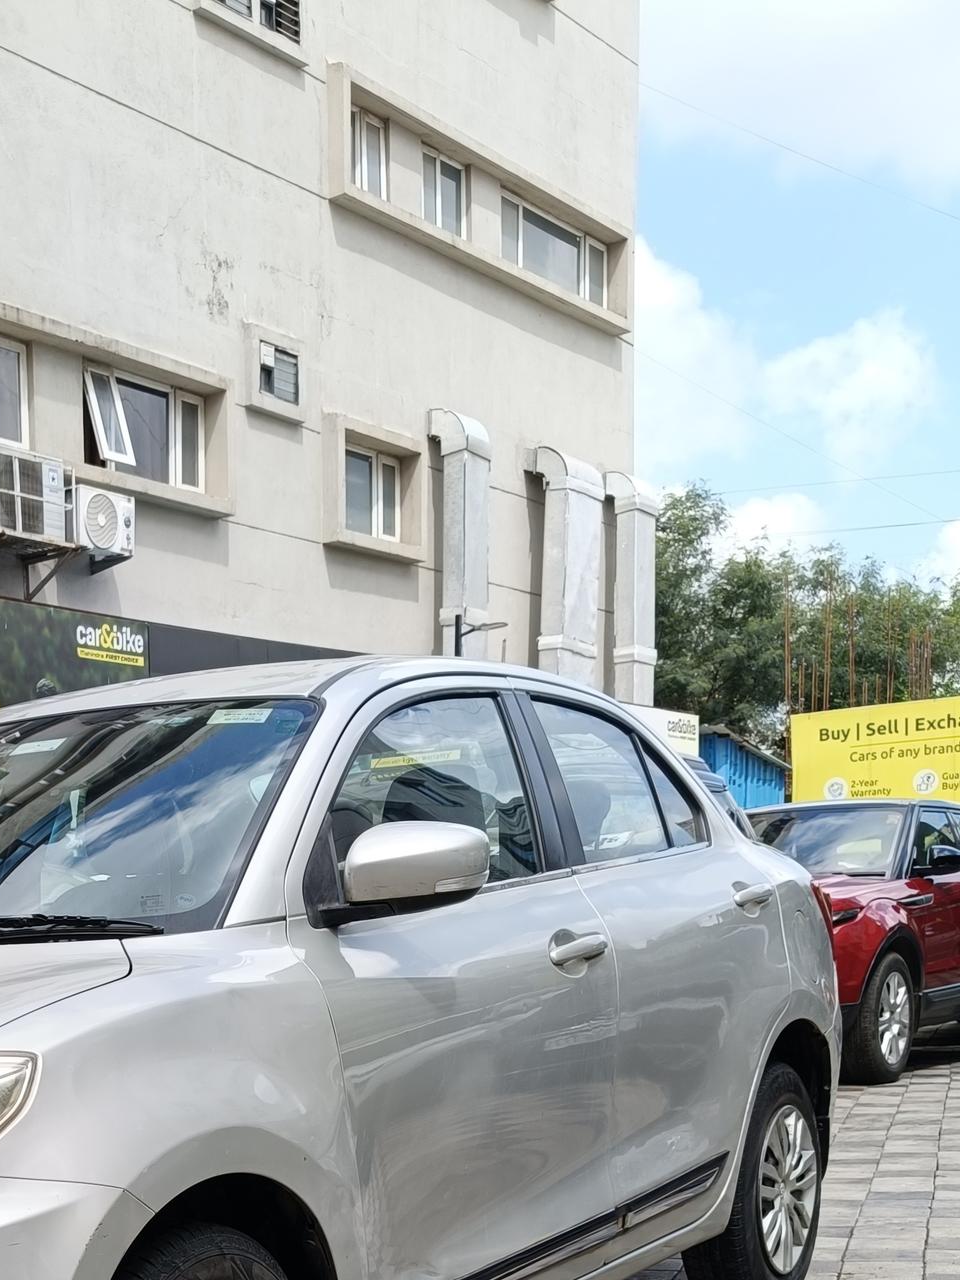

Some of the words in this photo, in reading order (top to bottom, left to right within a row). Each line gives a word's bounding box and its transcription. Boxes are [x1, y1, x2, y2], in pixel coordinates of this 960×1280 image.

[76, 623, 144, 654] car&bike
[819, 728, 850, 742] Buy
[866, 719, 898, 737] Sell
[850, 751, 877, 762] Cars
[881, 747, 895, 759] of
[897, 748, 920, 759] any
[851, 779, 878, 789] 2-Year
[851, 787, 891, 797] Warranty
